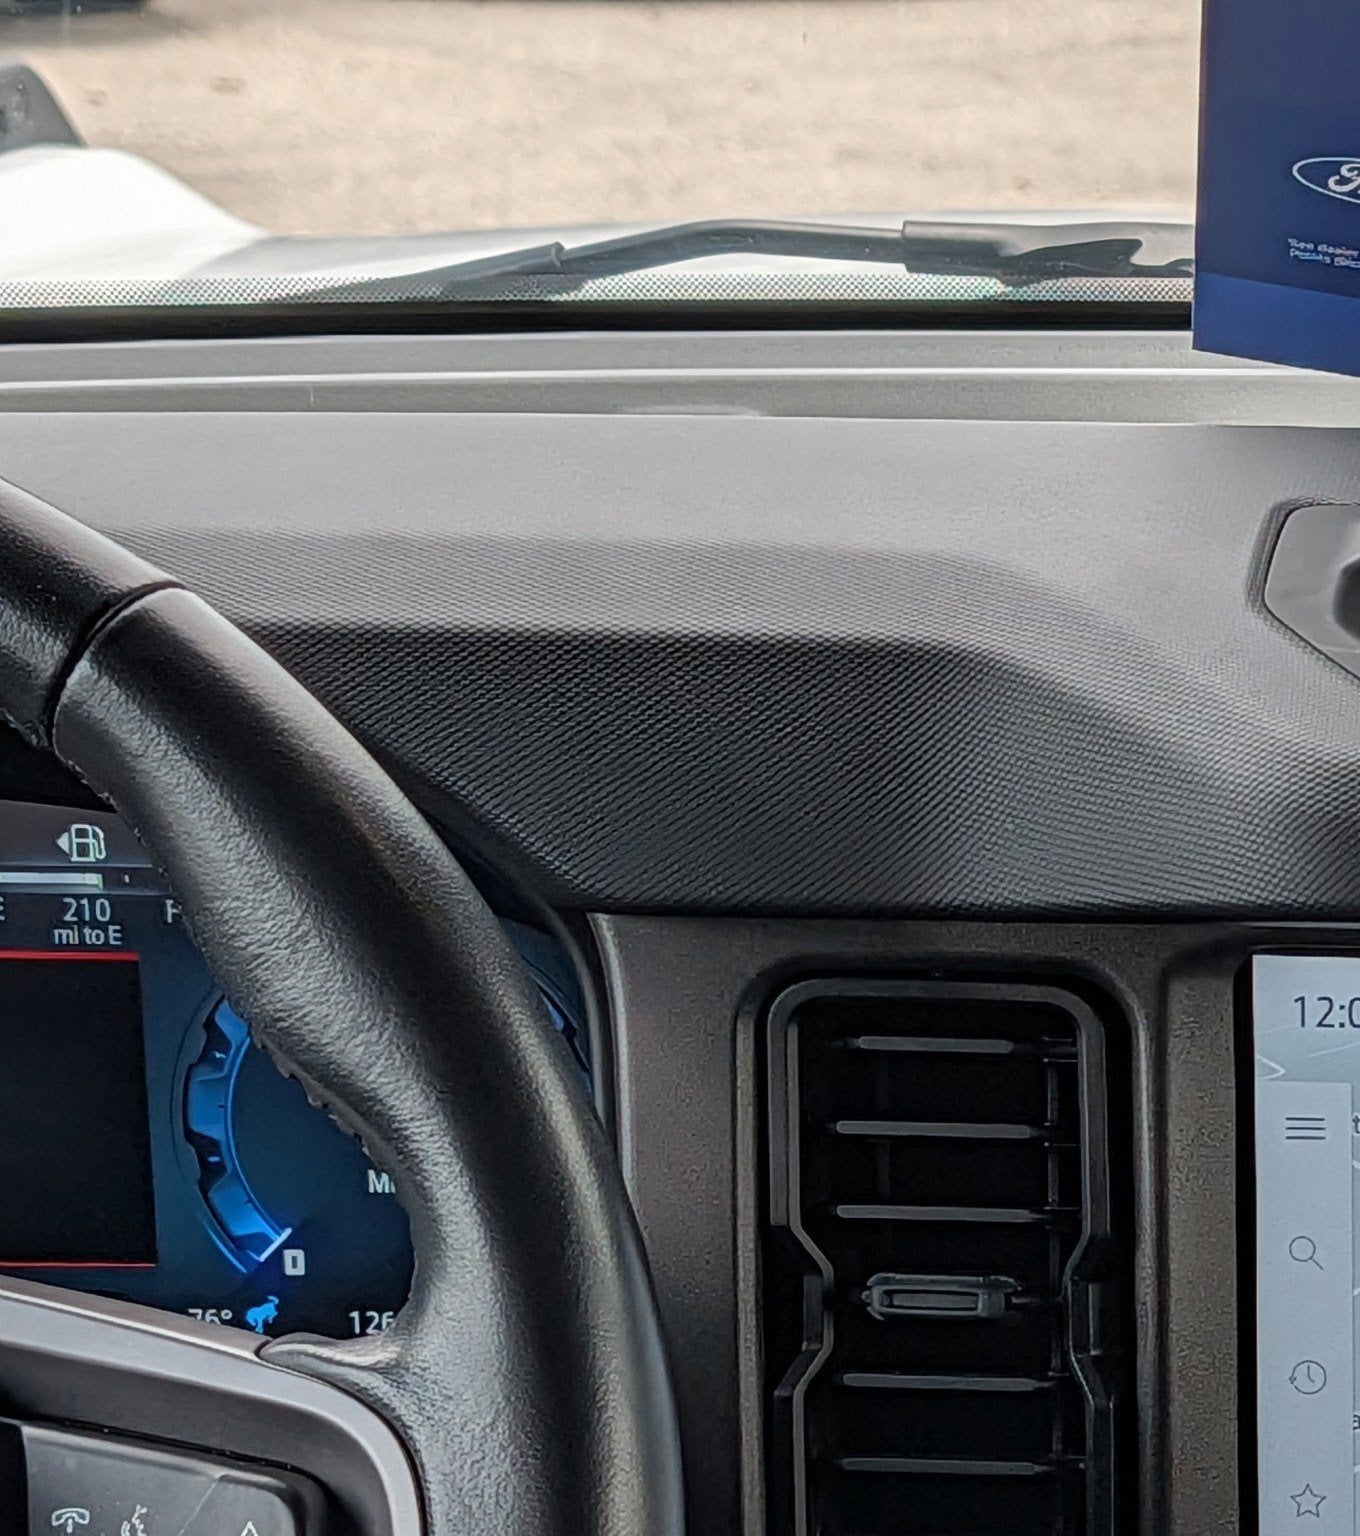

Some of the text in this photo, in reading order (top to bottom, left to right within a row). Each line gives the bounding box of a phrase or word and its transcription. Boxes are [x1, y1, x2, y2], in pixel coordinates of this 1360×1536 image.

[62, 897, 111, 922] 210
[83, 926, 105, 945] to
[109, 925, 123, 945] E
[367, 1169, 396, 1193] M
